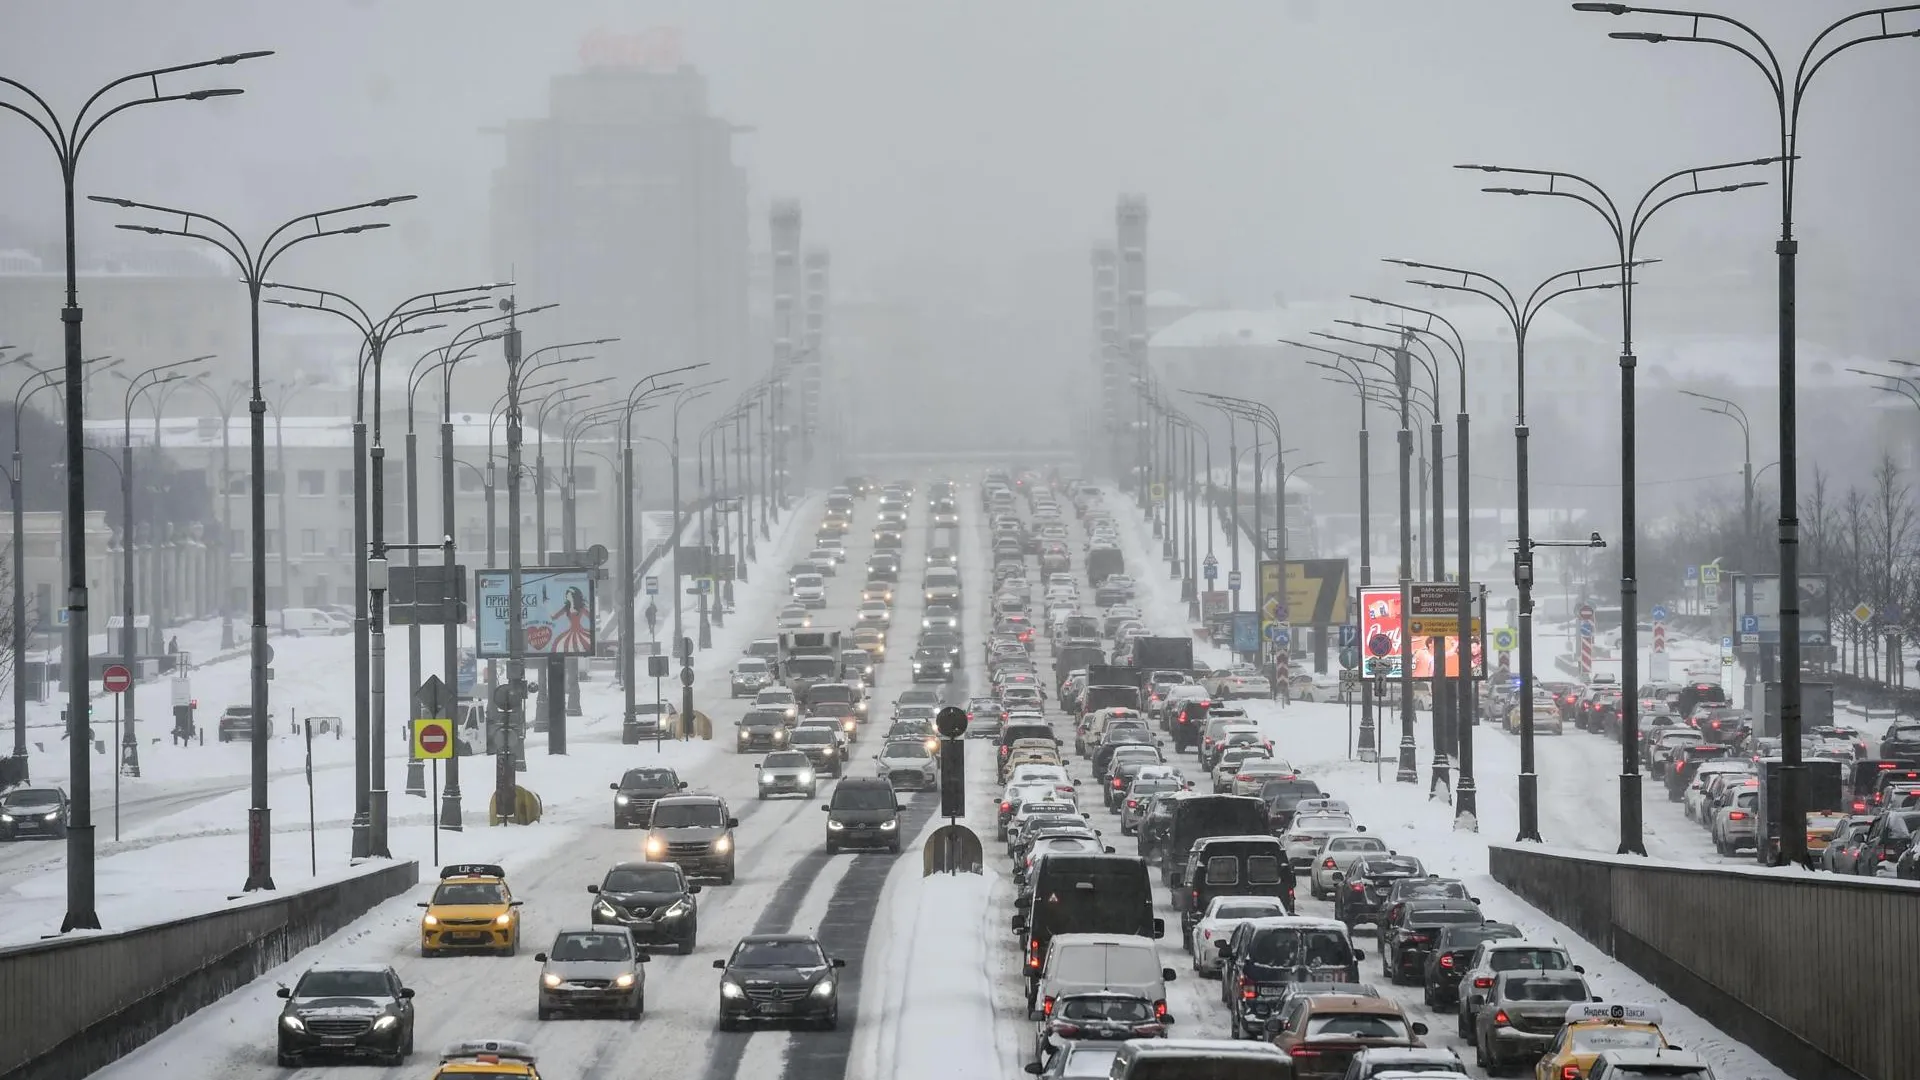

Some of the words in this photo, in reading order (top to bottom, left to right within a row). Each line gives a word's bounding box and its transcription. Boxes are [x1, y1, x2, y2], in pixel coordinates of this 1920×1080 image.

[486, 594, 537, 607] ПРИНССА
[495, 607, 528, 619] ЦИА
[1745, 618, 1755, 630] P
[1583, 1006, 1610, 1017] Яндекс
[1612, 1006, 1623, 1017] Go
[1625, 1007, 1645, 1017] Такси
